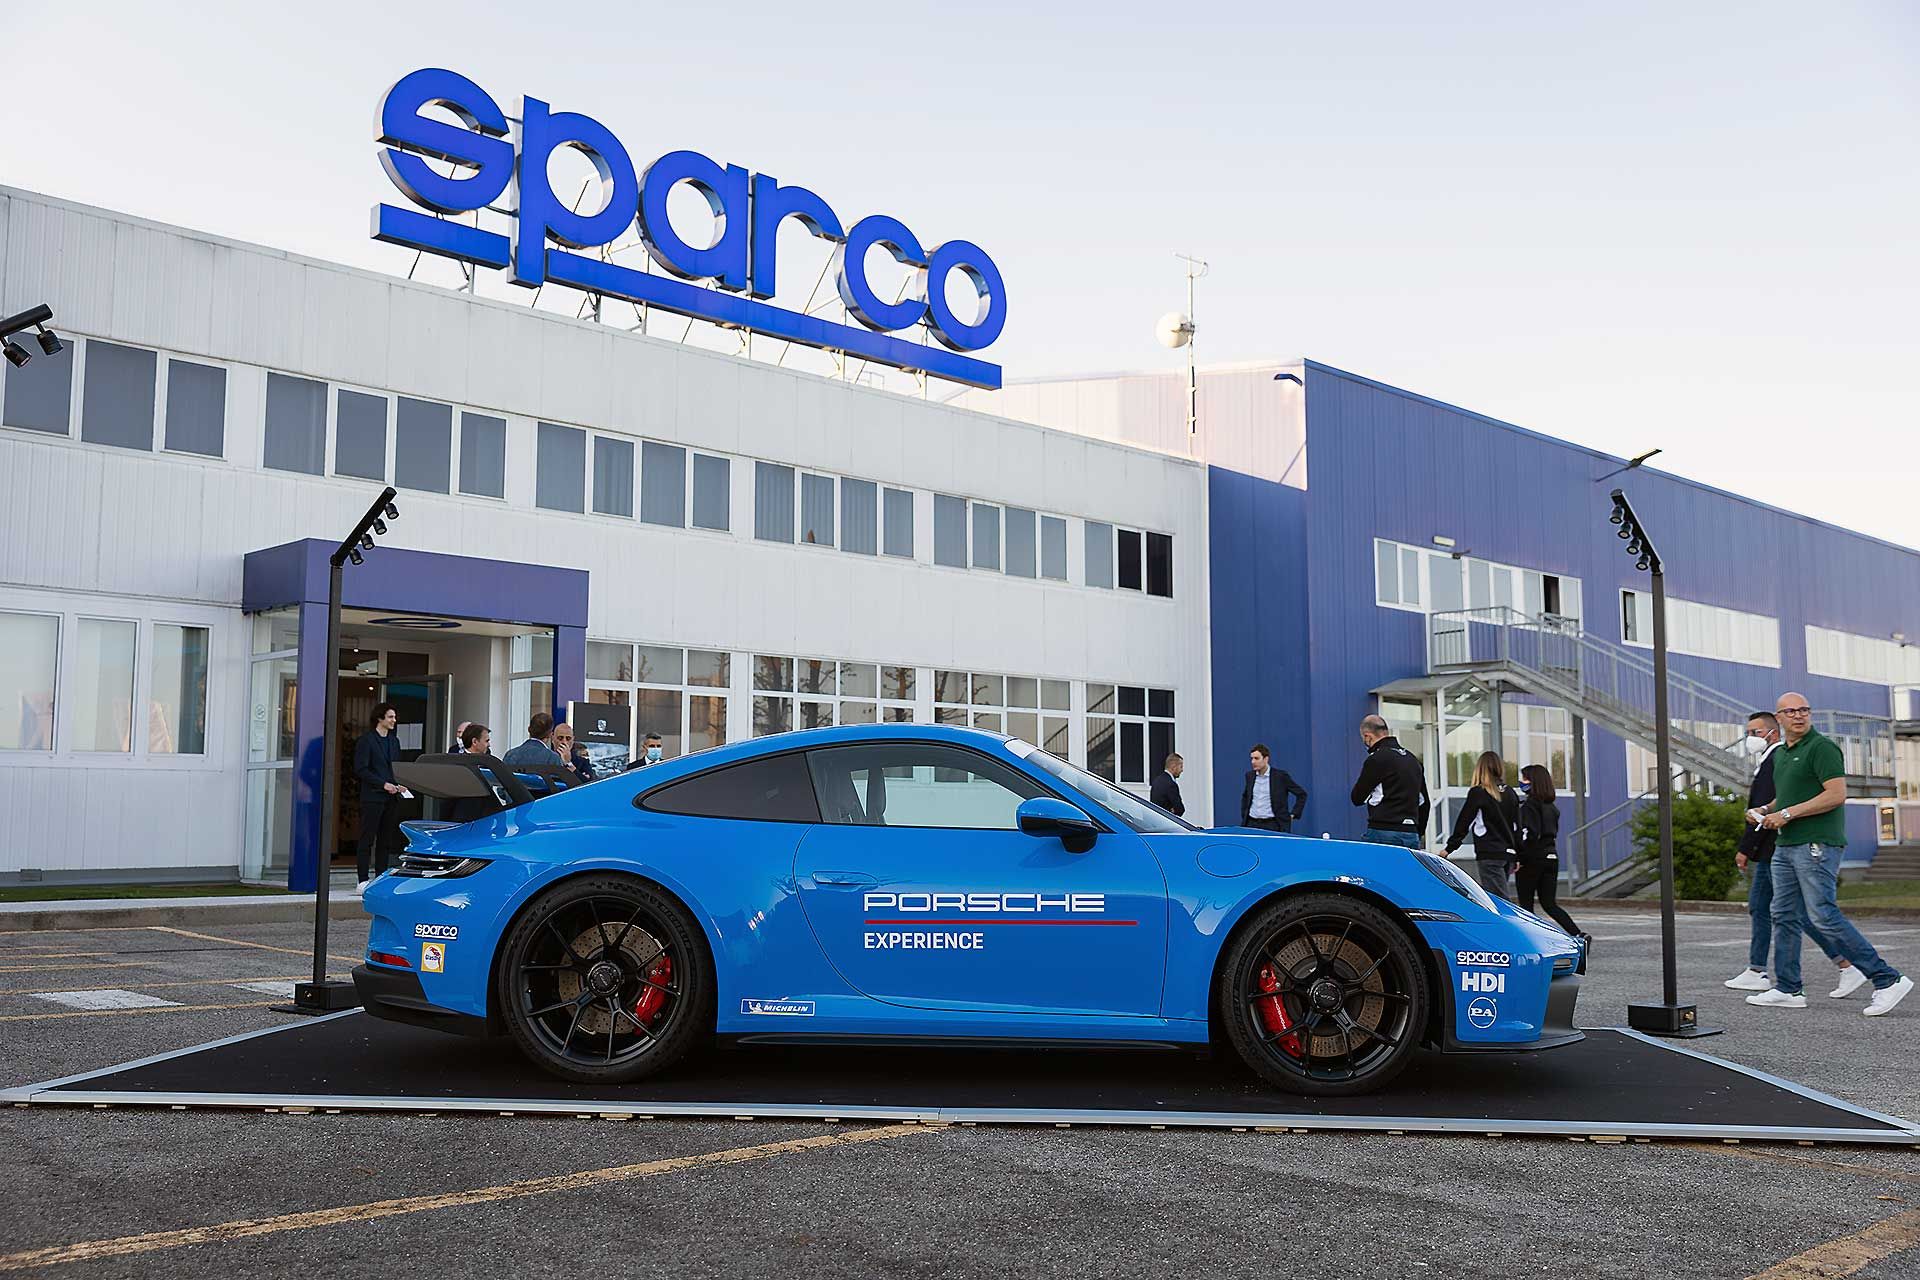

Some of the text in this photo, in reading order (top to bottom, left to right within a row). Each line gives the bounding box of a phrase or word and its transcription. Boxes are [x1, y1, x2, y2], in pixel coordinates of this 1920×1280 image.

[374, 67, 1008, 354] sparco
[863, 893, 1105, 913] PORSCHE
[415, 924, 458, 938] sparco
[863, 932, 984, 950] EXPERIENCE
[1457, 951, 1510, 967] sparco
[1461, 971, 1505, 993] HDI
[763, 1004, 809, 1012] MICHELIN
